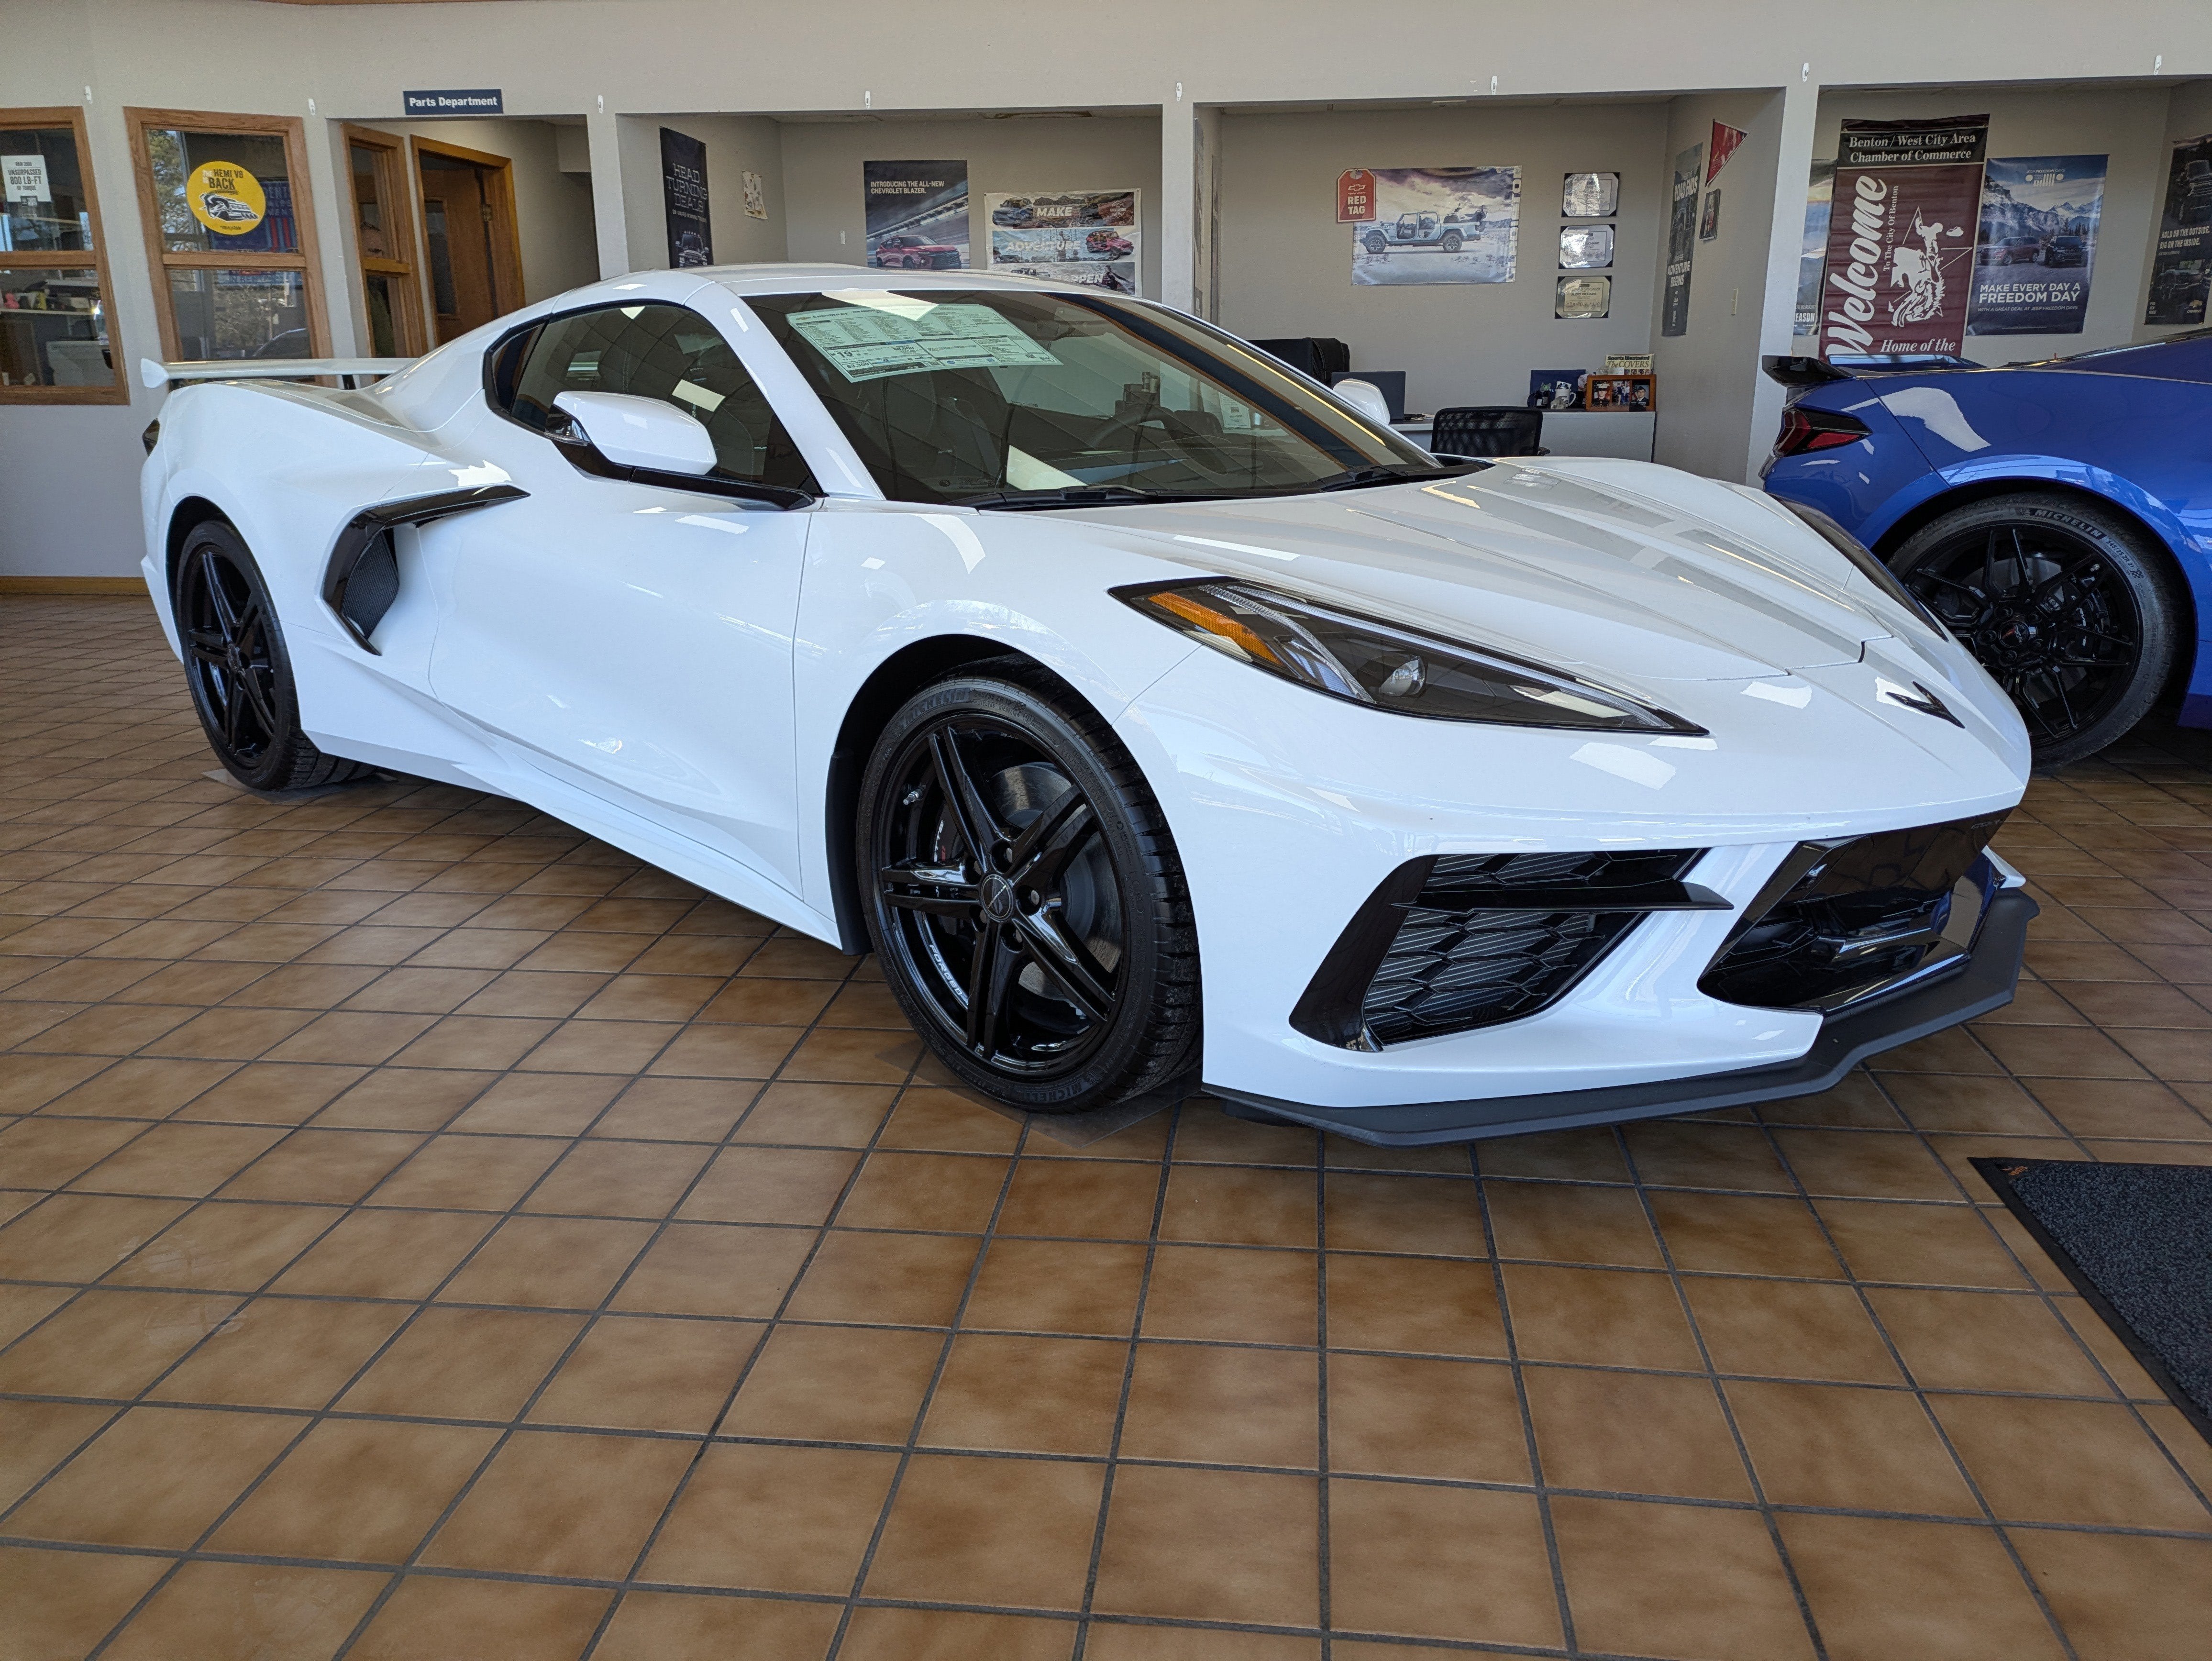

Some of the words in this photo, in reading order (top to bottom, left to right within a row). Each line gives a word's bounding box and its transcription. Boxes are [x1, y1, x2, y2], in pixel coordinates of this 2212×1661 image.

[409, 97, 436, 106] Parts
[439, 97, 498, 108] Department
[1849, 137, 1888, 147] Benton
[1897, 134, 1922, 146] West
[1925, 134, 1948, 146] City
[1950, 133, 1976, 144] Area
[1850, 152, 1899, 163] Chamber
[1901, 150, 1913, 161] of
[1915, 149, 1972, 161] Commerce
[213, 169, 232, 177] HEMI
[234, 170, 243, 178] V8
[673, 163, 700, 183] HEAD
[11, 177, 22, 185] 800
[23, 177, 41, 185] LB-FT
[209, 177, 235, 190] BACK
[666, 176, 708, 200] TURNING
[674, 193, 704, 212] DEALS
[1348, 196, 1366, 205] RED
[1889, 186, 1899, 214] Benton
[1036, 207, 1073, 217] MAKE
[1348, 206, 1365, 215] TAG
[1888, 215, 1895, 225] Of
[1886, 225, 1895, 244] City
[2161, 231, 2173, 239] BOLD
[2173, 230, 2179, 238] ON
[1006, 241, 1082, 251] ADVENTURE
[2183, 238, 2201, 247] INSIDE.
[1884, 244, 1892, 260] The
[1668, 261, 1691, 276] ADVENTURE
[1825, 176, 1887, 355] Welcome
[1883, 262, 1891, 271] To
[1670, 274, 1684, 287] BEGINS
[2013, 284, 2046, 292] EVERY
[2049, 283, 2071, 291] DAY
[2073, 282, 2080, 290] A
[1979, 292, 2047, 303] FREEDOM
[2051, 291, 2080, 302] DAY
[1795, 312, 1815, 322] EASON
[1880, 339, 1917, 352] Home
[1920, 339, 1935, 352] of
[1936, 338, 1956, 352] the
[2035, 509, 2102, 537] MICHELIN
[2106, 540, 2124, 555] 345/25
[2122, 555, 2130, 564] ZR
[902, 687, 970, 725] MICHELIN
[1122, 831, 1134, 856] MICHELIN
[929, 944, 962, 996] FORGED
